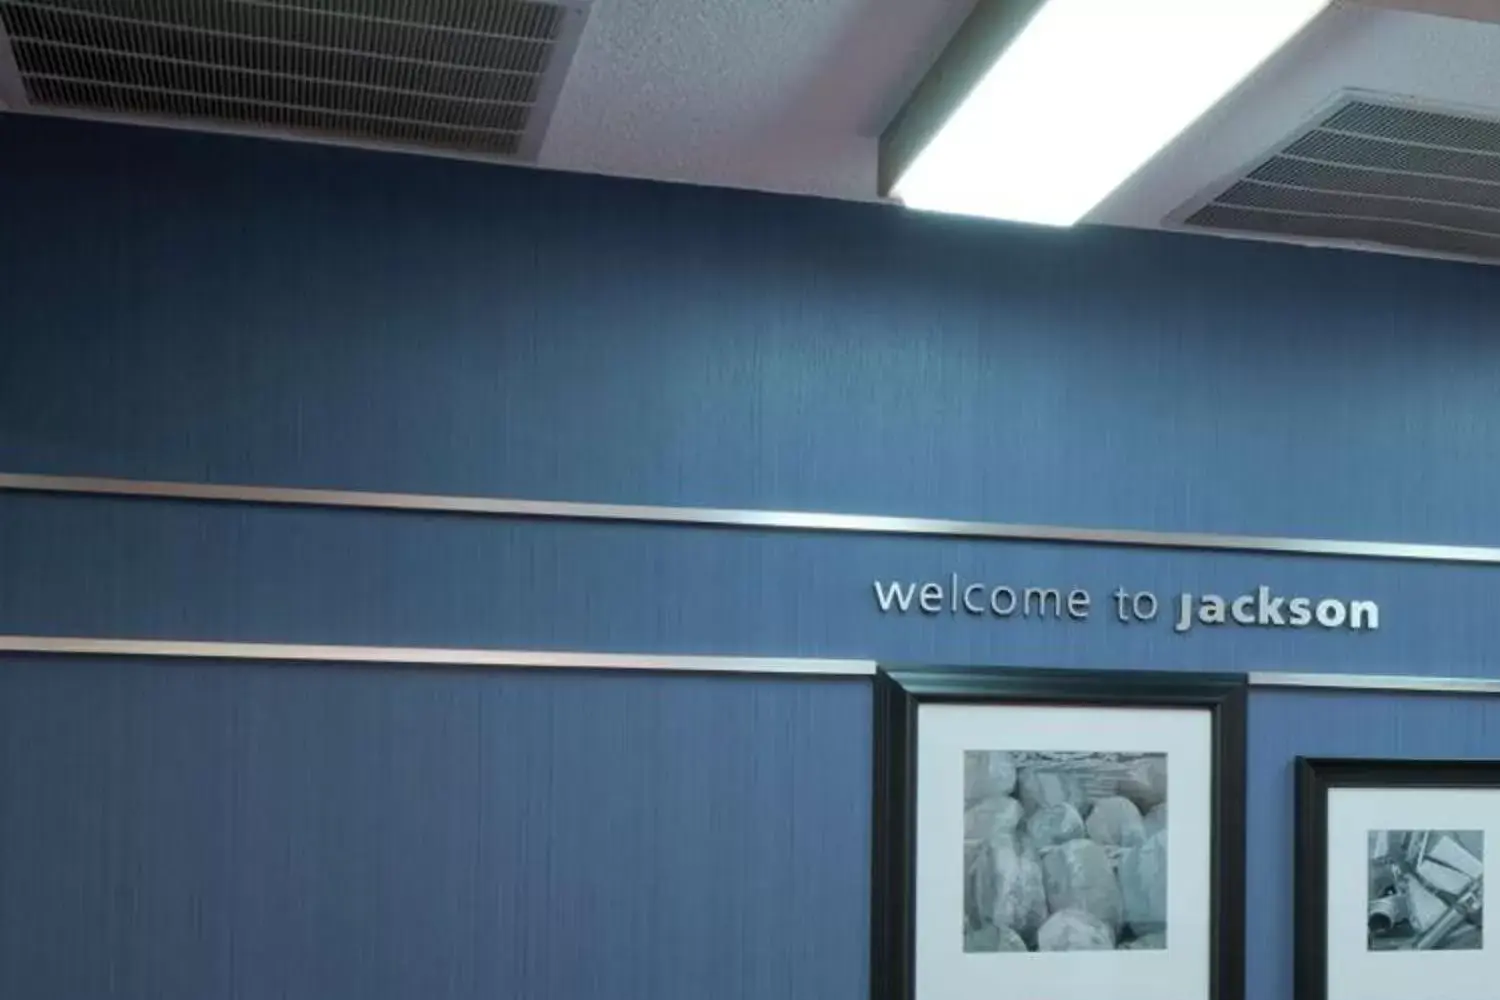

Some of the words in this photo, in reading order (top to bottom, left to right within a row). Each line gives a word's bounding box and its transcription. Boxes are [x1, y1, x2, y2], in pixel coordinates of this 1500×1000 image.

[874, 574, 1091, 618] welcome
[1113, 586, 1158, 621] to
[1174, 585, 1380, 631] jackson
